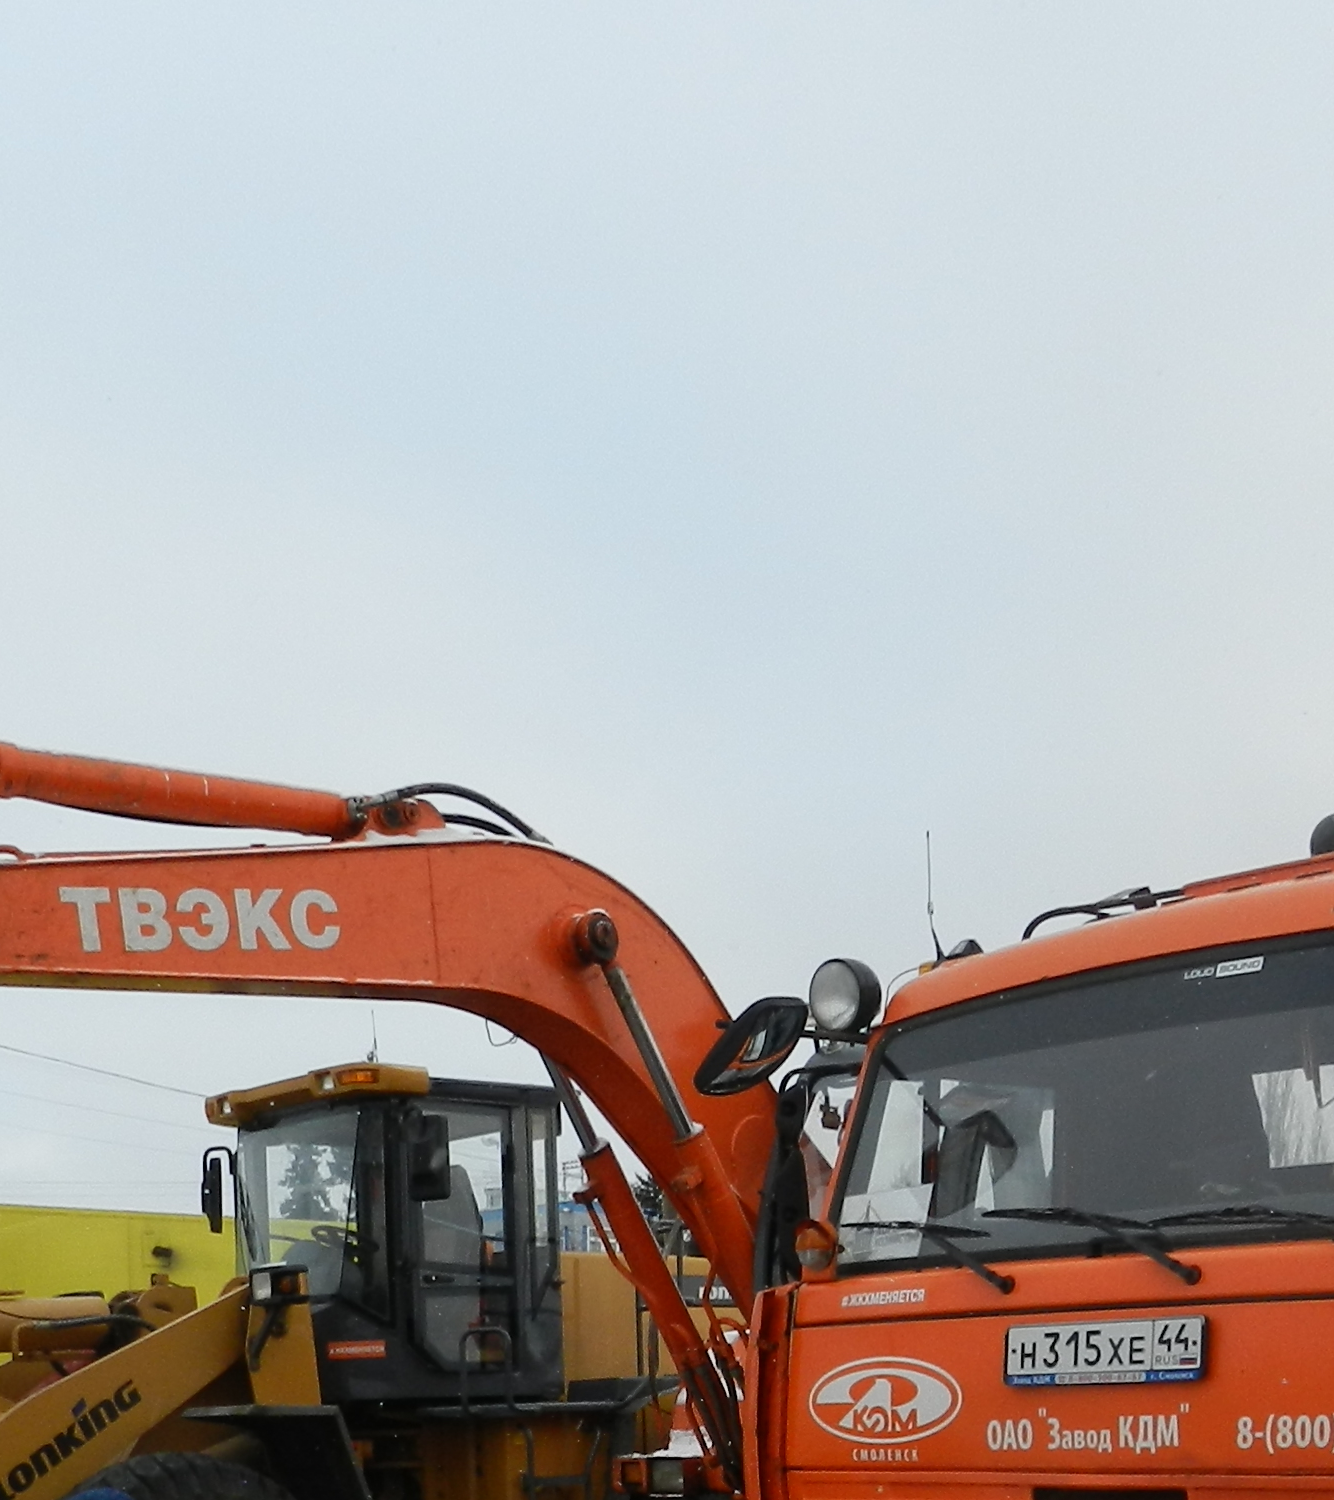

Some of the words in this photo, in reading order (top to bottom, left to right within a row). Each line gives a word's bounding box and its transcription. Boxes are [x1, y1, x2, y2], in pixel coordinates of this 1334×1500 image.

[58, 886, 341, 952] ТВЭКС
[1157, 1323, 1190, 1353] 44
[1154, 1354, 1179, 1366] RUS
[986, 1418, 1034, 1451] ОАО
[852, 1448, 919, 1462] СМОЛЕНСК
